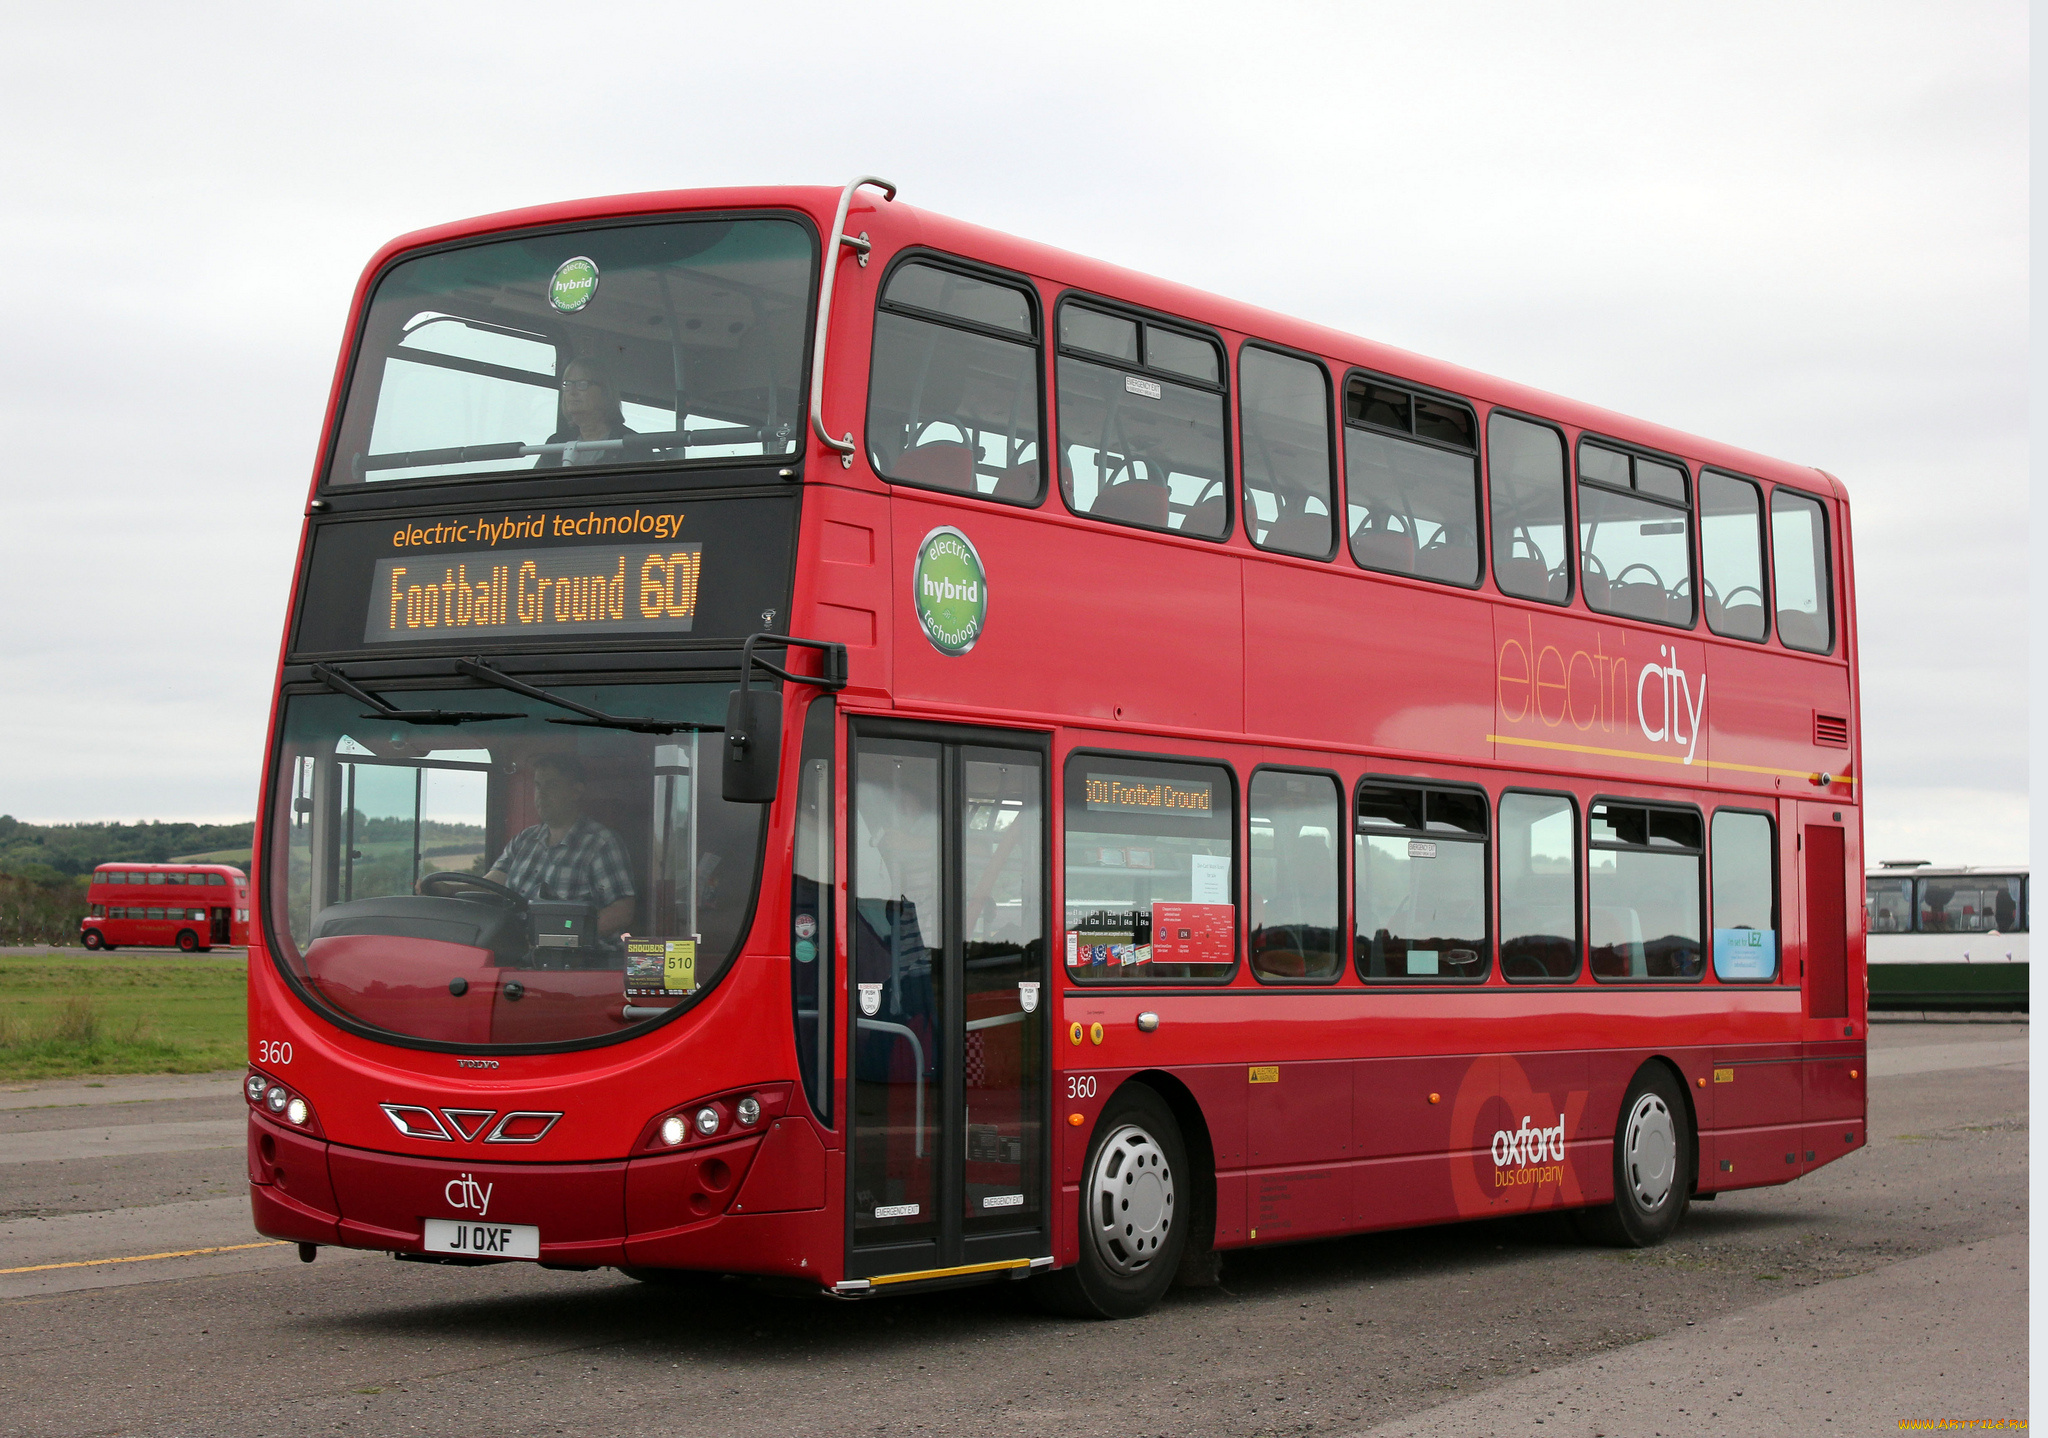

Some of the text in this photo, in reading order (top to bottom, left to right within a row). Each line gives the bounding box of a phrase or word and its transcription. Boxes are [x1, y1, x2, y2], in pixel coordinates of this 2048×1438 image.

[562, 262, 590, 275] electric
[555, 277, 592, 293] hybrid
[553, 293, 589, 309] technology
[392, 509, 685, 547] electric-hybrid technology
[929, 539, 971, 566] electric
[390, 564, 508, 629] Football
[518, 556, 626, 624] Ground
[923, 573, 978, 603] hybrid
[924, 609, 978, 645] technology
[1112, 781, 1161, 807] Football
[1164, 785, 1209, 810] Ground
[668, 957, 692, 969] 510
[259, 1040, 293, 1065] 360
[456, 1059, 499, 1069] VOLVO
[1067, 1076, 1097, 1099] 360
[1491, 1113, 1565, 1169] oxford
[1495, 1165, 1564, 1189] bus company
[445, 1173, 493, 1216] city
[473, 1227, 512, 1252] OXF
